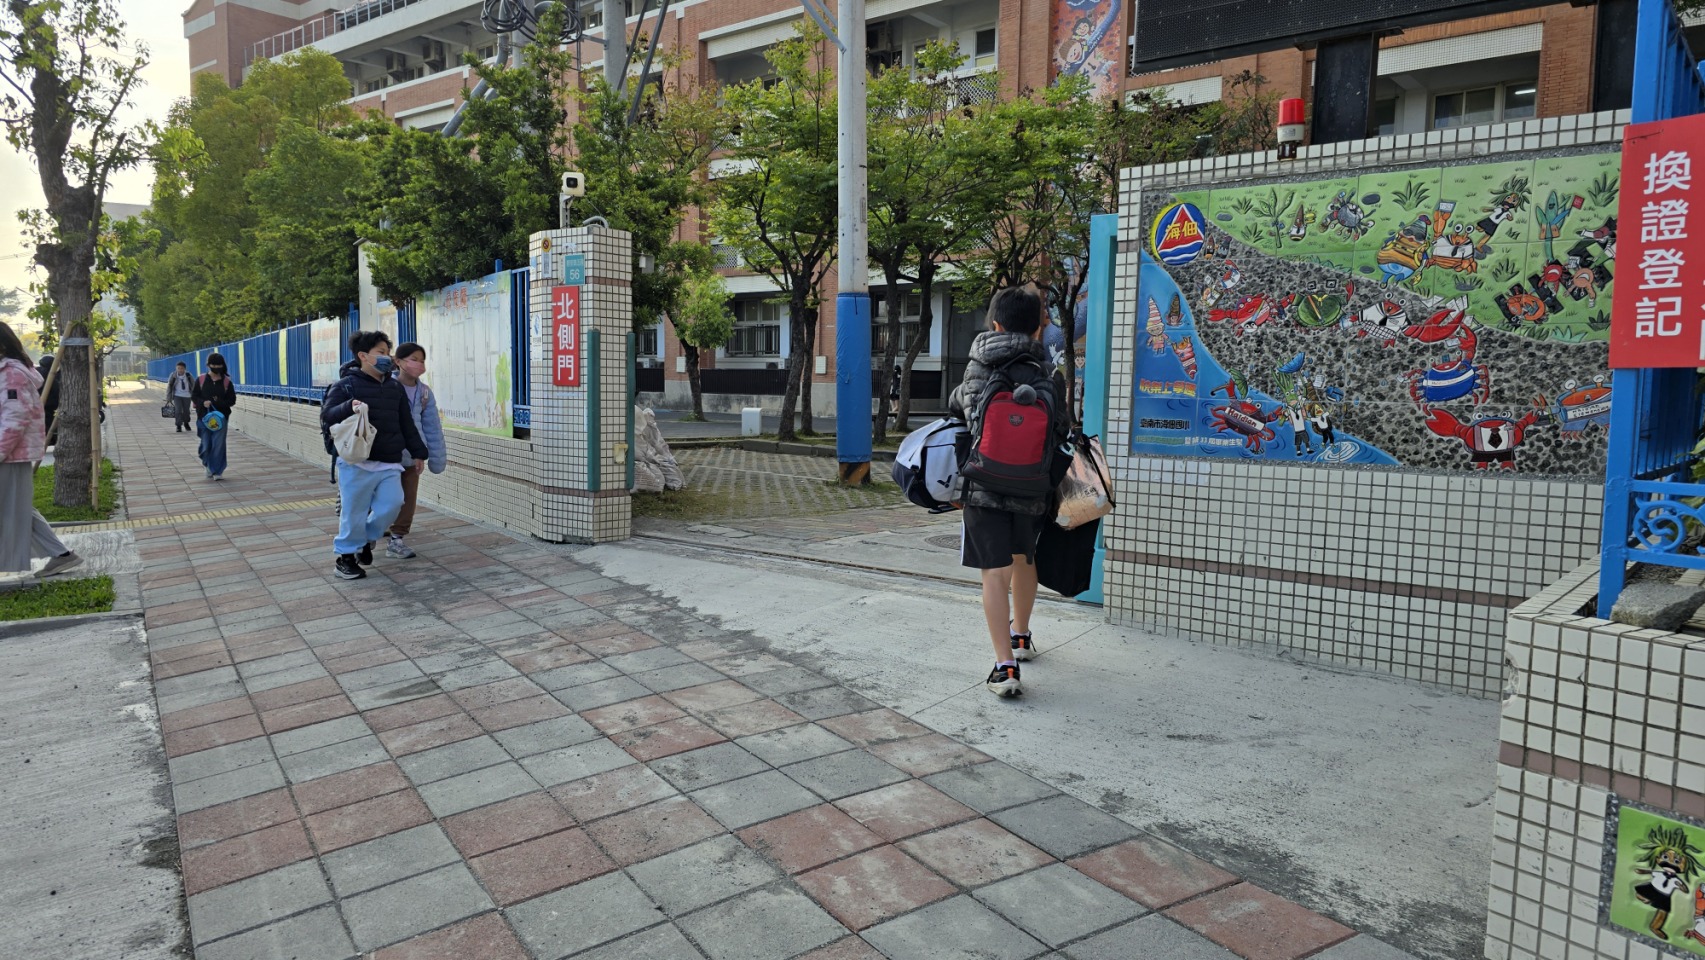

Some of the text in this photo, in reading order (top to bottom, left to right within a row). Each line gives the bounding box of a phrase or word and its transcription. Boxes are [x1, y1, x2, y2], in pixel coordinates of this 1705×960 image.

[1166, 221, 1198, 240] 海佃
[1635, 150, 1691, 338] 換證登記
[569, 268, 580, 280] 56
[557, 292, 575, 381] 北側門
[1228, 408, 1257, 428] Haidian
